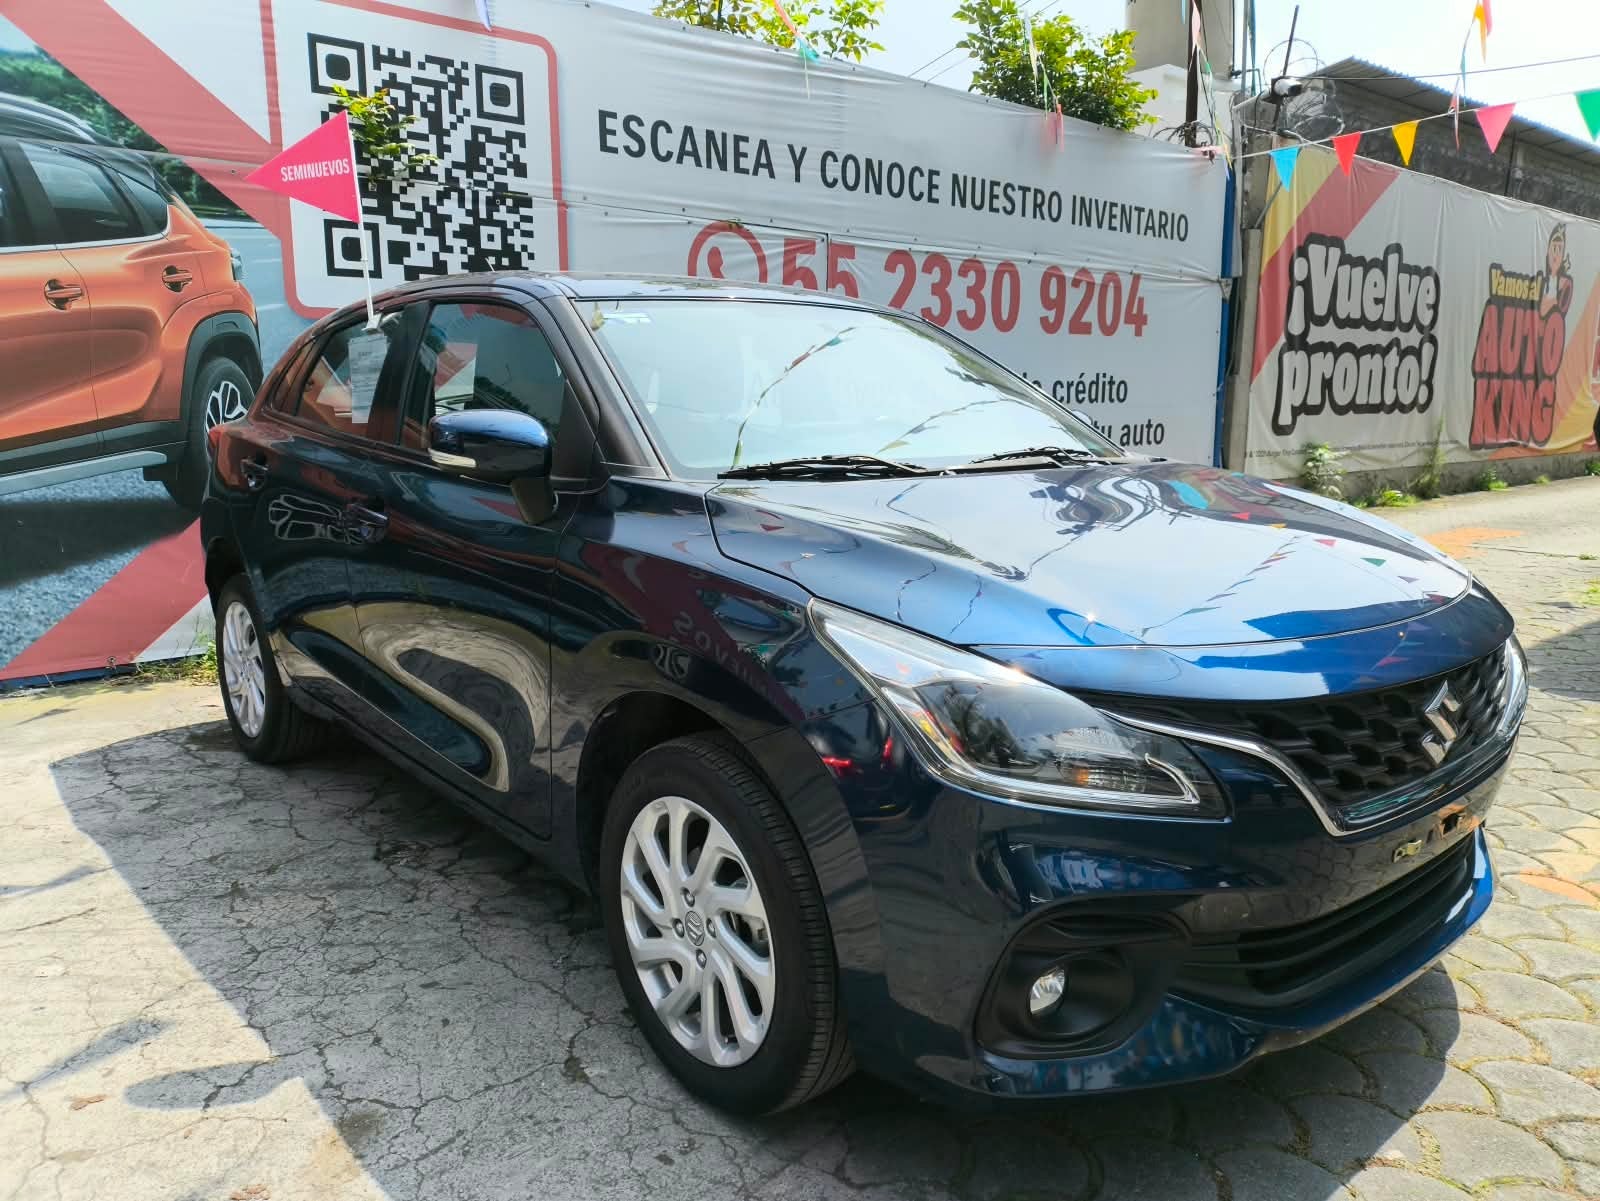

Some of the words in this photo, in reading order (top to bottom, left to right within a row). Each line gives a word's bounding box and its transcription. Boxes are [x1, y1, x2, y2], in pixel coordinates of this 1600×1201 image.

[280, 158, 351, 183] SEMINUEVOS
[598, 109, 776, 180] ESCANEA
[787, 143, 808, 184] Y
[820, 150, 941, 205] CONOCE
[951, 173, 1063, 223] NUESTRO
[1071, 194, 1190, 243] INVENTARIO
[781, 237, 860, 299] 55
[883, 249, 1022, 334] 2330
[1039, 264, 1149, 338] 9204
[1286, 235, 1440, 344] ¡Vuelve
[1489, 265, 1530, 301] Vamos
[1473, 300, 1566, 377] AUTO
[1052, 372, 1128, 405] crédito
[1273, 337, 1438, 434] pronto!
[1470, 376, 1556, 450] KING
[1119, 418, 1165, 448] auto
